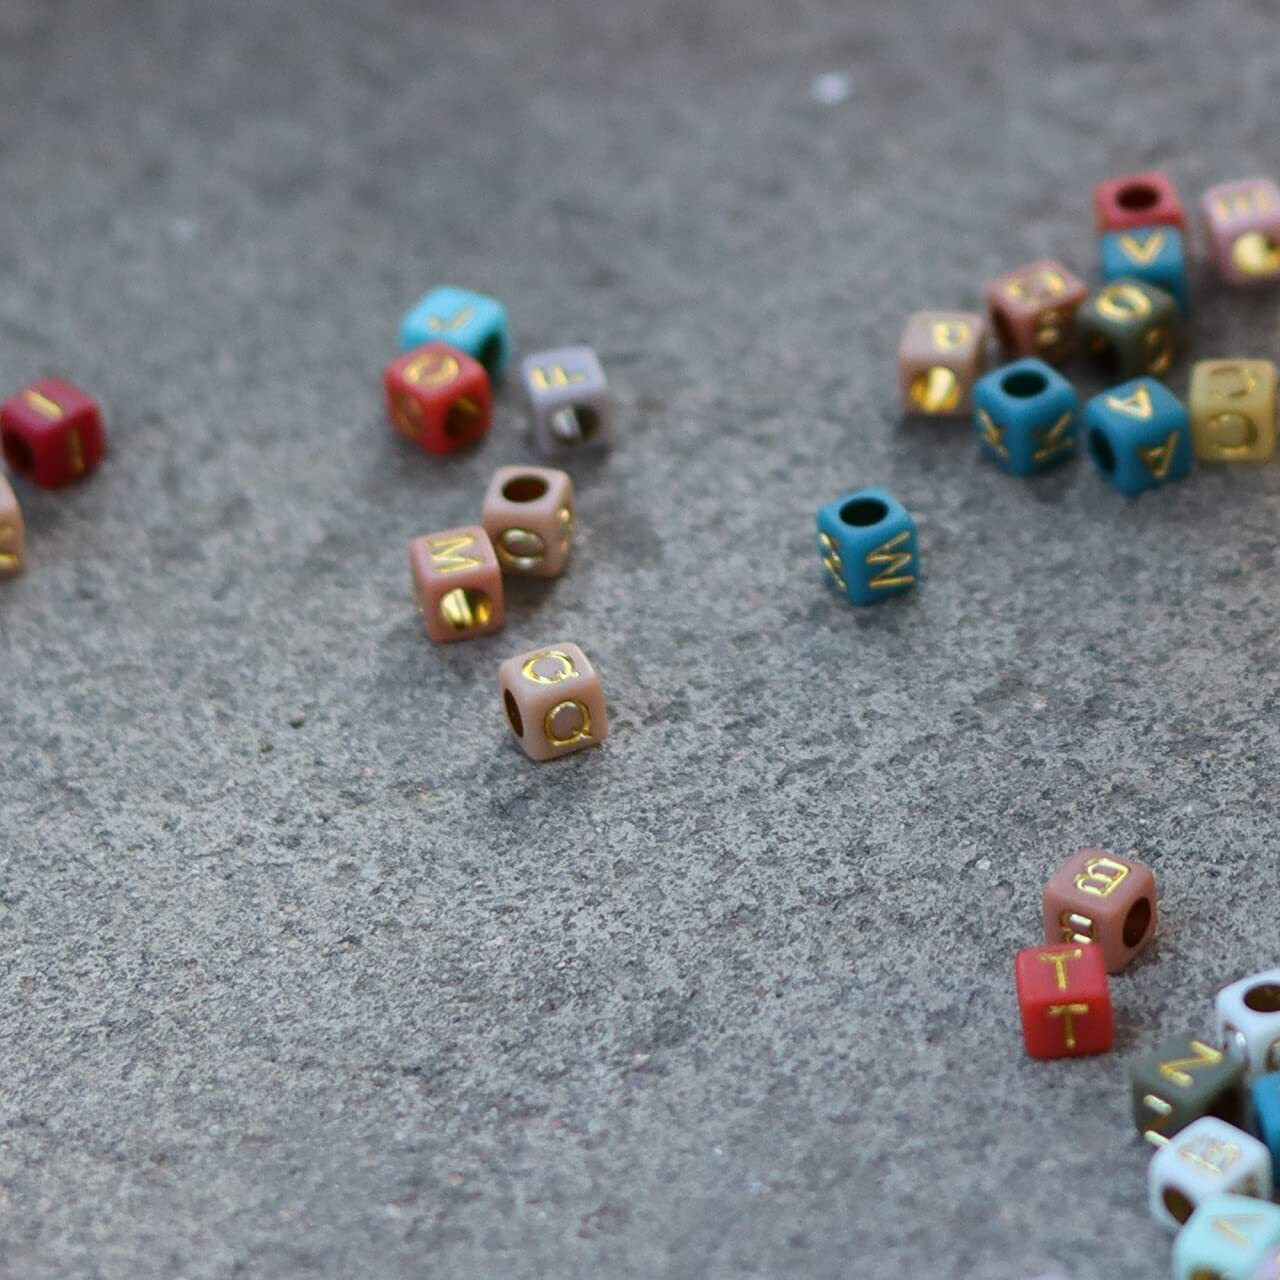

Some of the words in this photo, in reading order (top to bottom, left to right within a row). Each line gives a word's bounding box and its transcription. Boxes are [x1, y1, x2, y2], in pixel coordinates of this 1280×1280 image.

[1103, 383, 1153, 419] A
[520, 649, 582, 686] Q
[542, 699, 594, 748] Q
[1038, 947, 1084, 992] T
[1048, 1001, 1090, 1050] T
